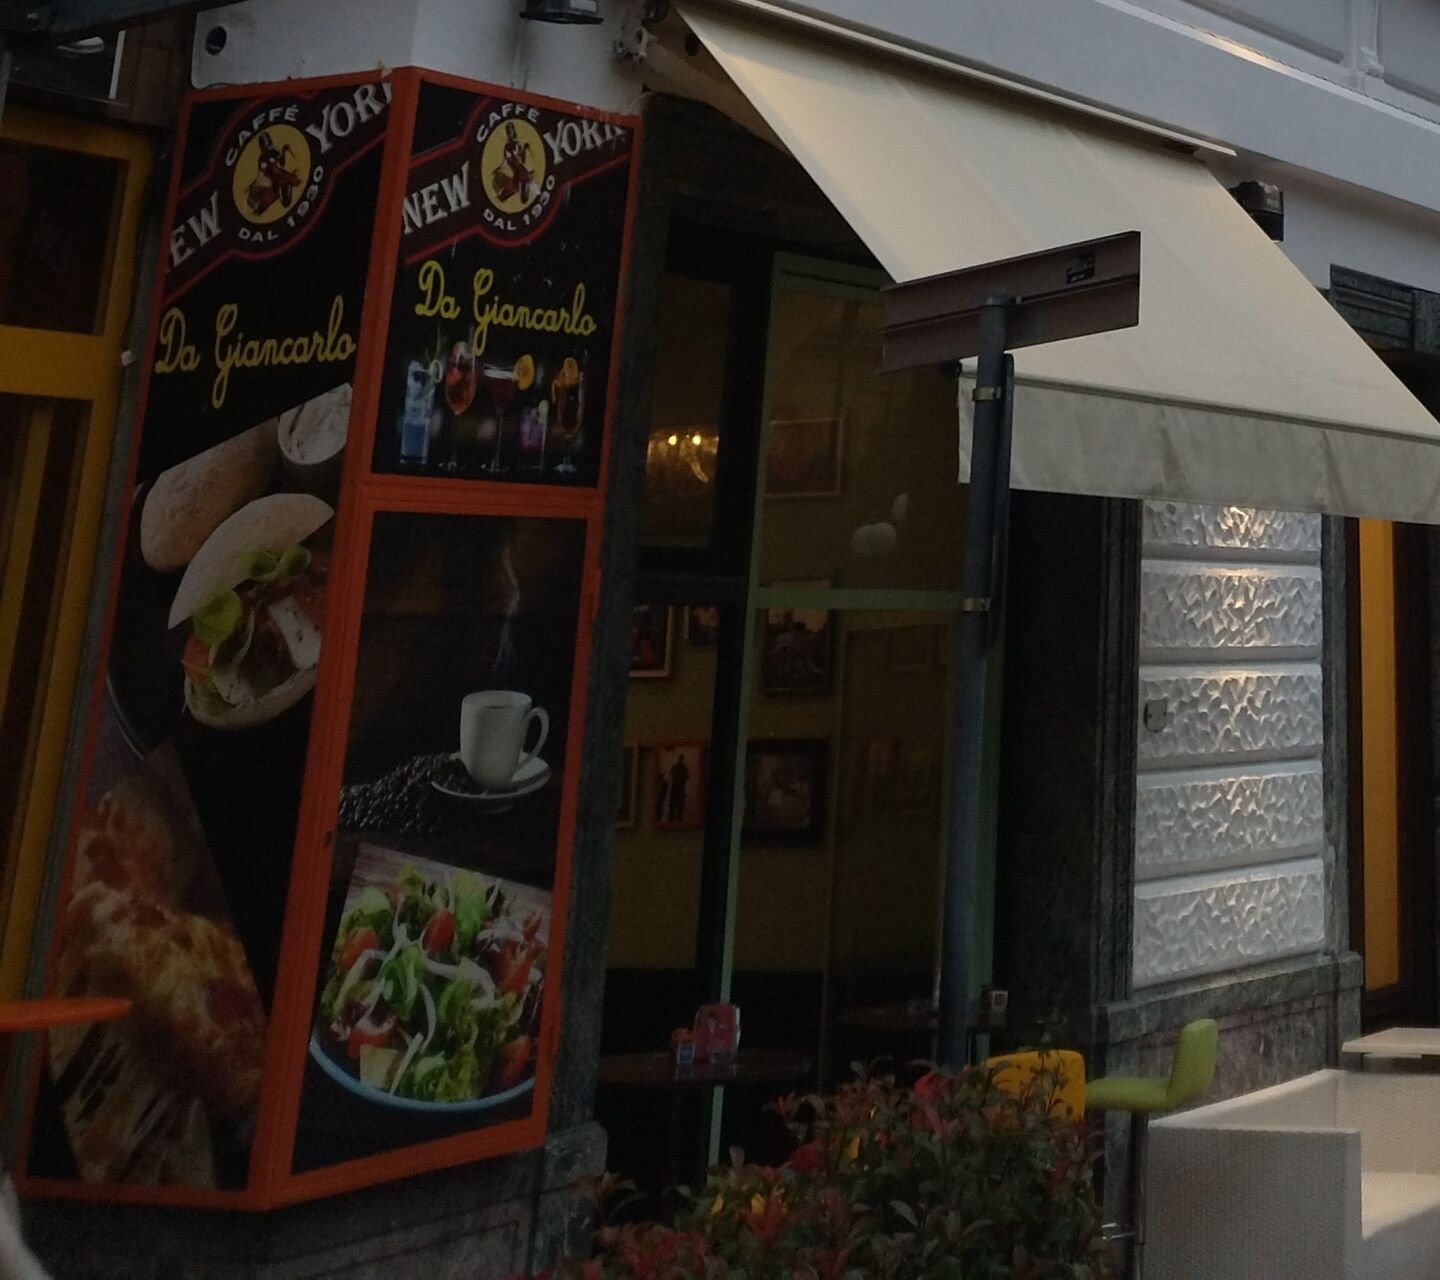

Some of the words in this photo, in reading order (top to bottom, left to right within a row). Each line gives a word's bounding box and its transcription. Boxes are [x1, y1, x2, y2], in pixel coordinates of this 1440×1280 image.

[168, 189, 225, 268] EW
[238, 226, 279, 242] DAL
[286, 164, 324, 228] 1930
[401, 160, 472, 236] NEW
[482, 207, 517, 231] DAL
[521, 174, 556, 226] 1930
[414, 259, 462, 320] Da
[472, 267, 598, 357] Giancarlo
[154, 306, 202, 374] Da
[211, 293, 357, 410] Giancarlo
